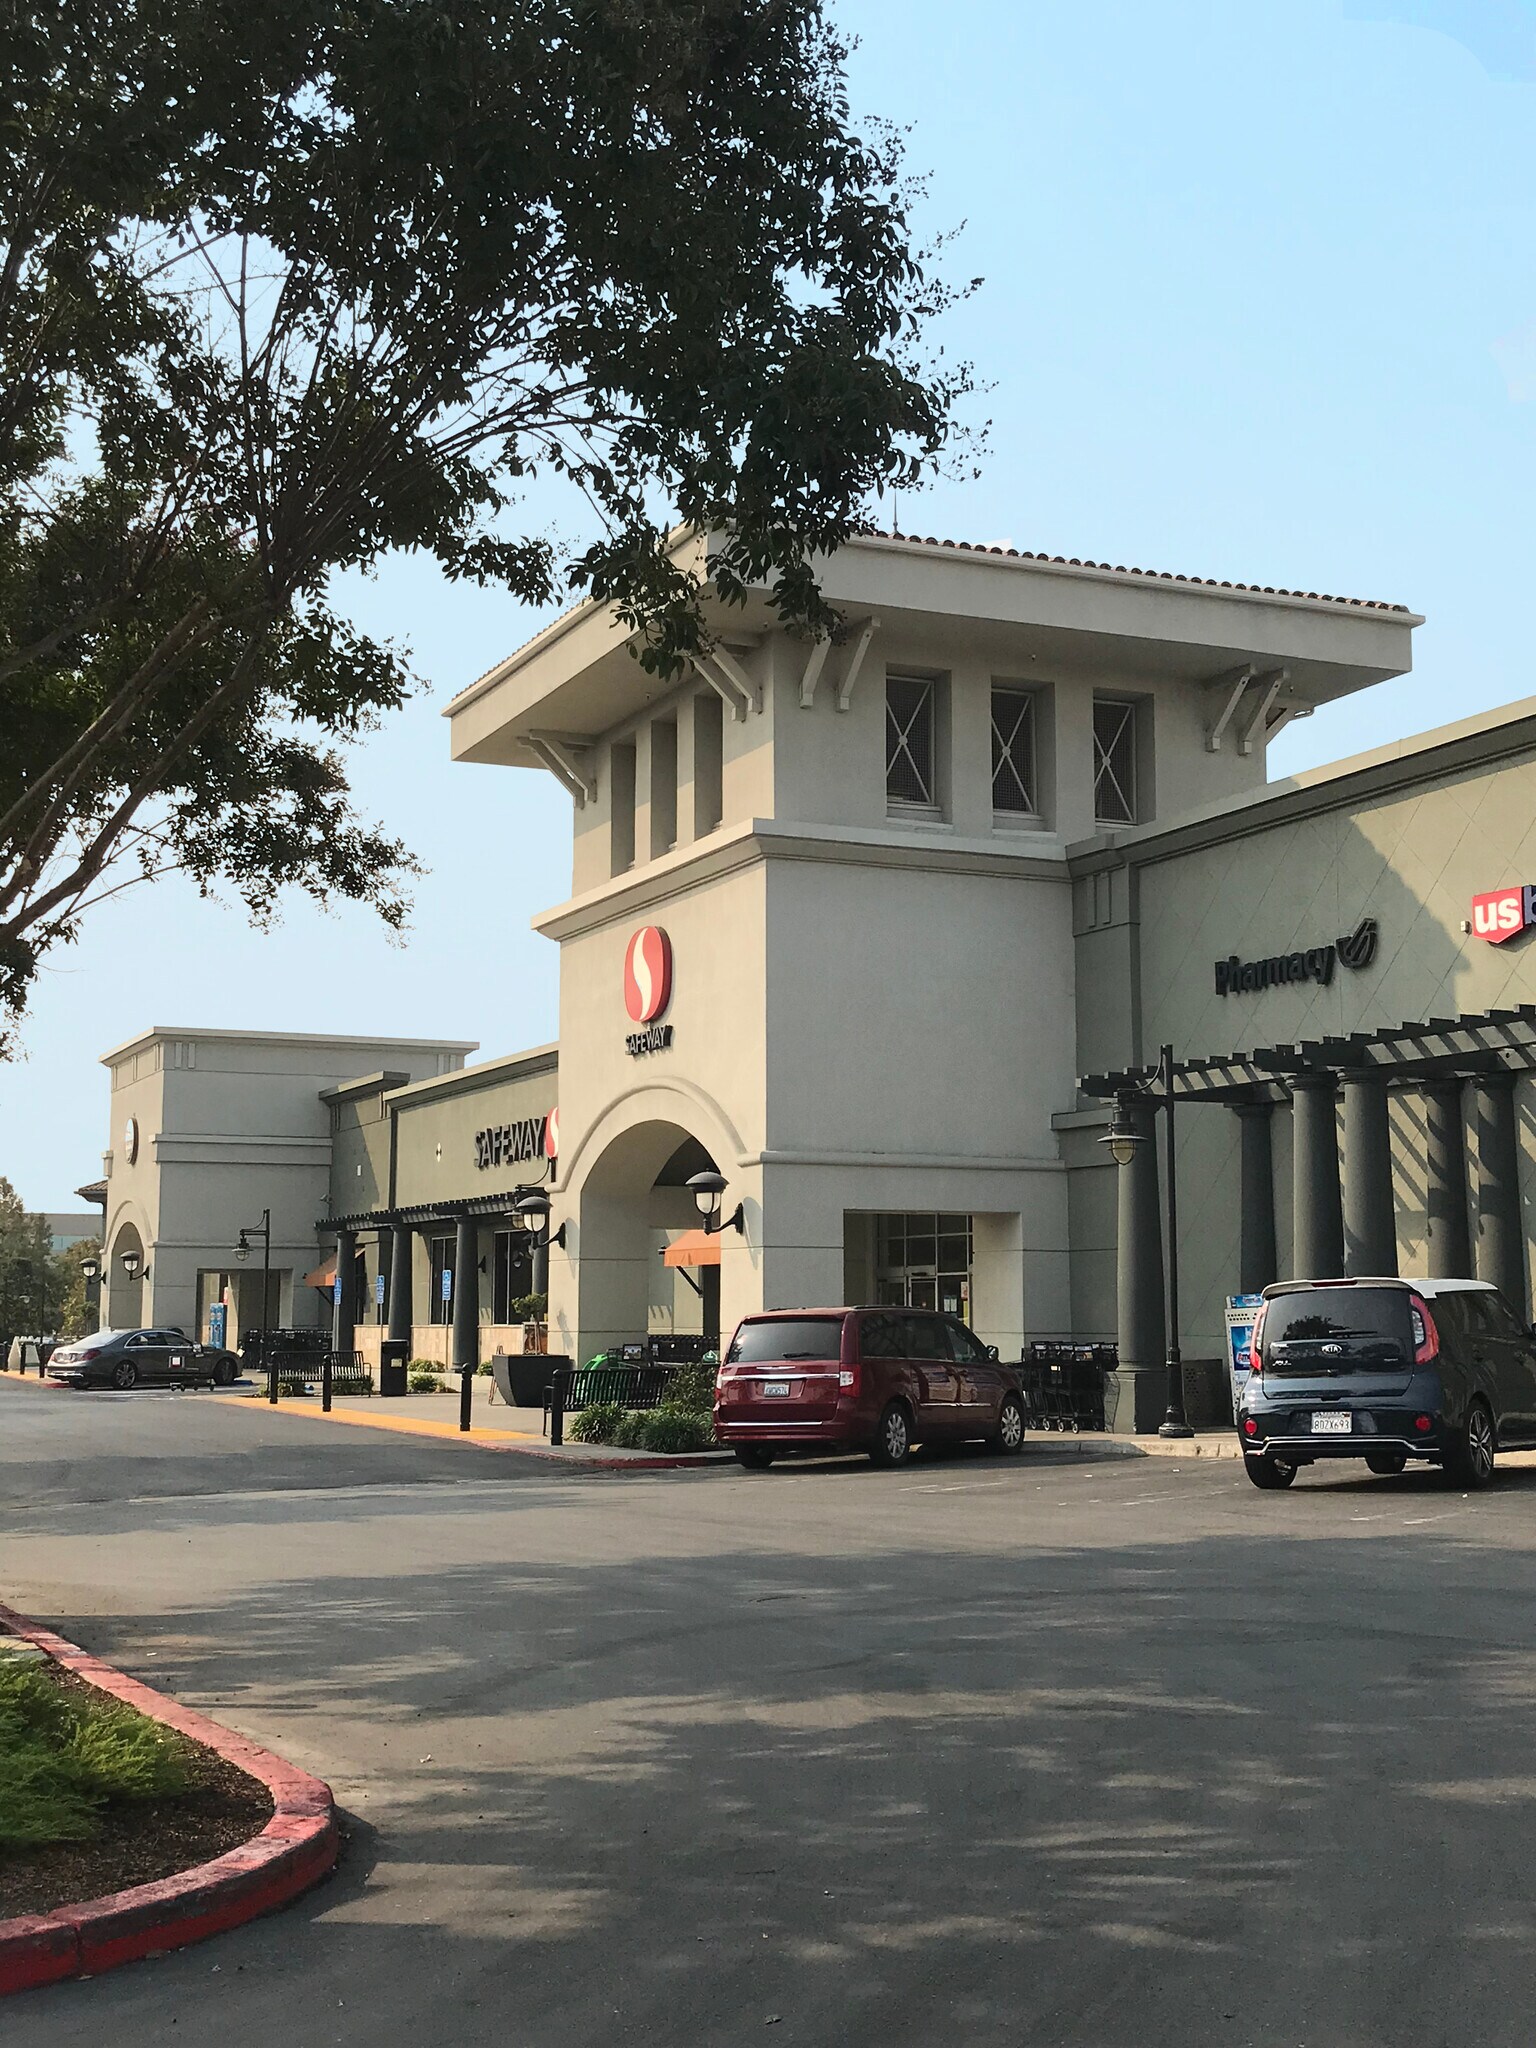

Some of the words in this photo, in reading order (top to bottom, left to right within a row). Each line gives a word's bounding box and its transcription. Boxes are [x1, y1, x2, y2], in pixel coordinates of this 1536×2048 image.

[1474, 897, 1521, 934] us
[1214, 945, 1336, 996] Pharmacy
[625, 1025, 673, 1055] SAFEWAY
[474, 1116, 548, 1168] SAFEWAY
